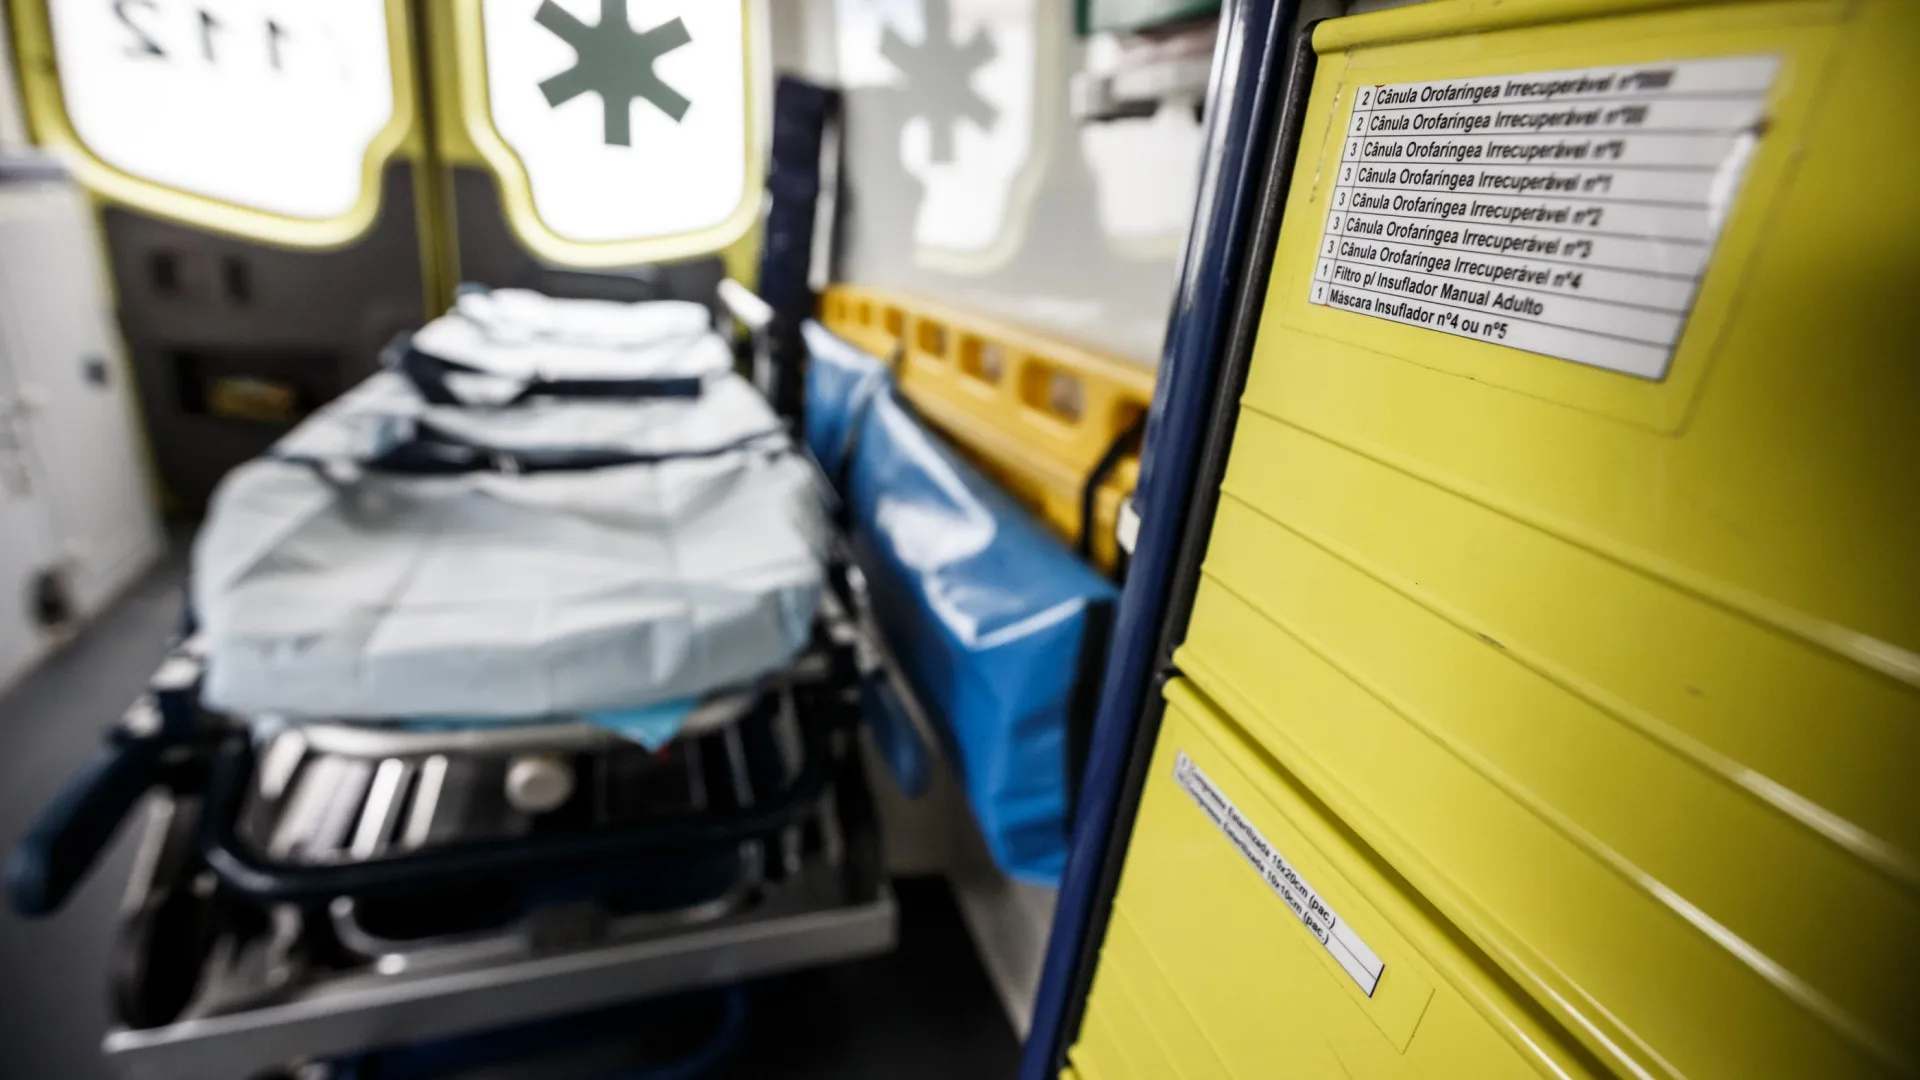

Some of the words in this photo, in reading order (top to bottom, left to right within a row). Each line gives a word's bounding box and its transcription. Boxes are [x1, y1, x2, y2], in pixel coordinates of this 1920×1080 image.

[1362, 91, 1370, 106] 2
[1377, 87, 1417, 105] Cânula
[1421, 83, 1500, 103] Orofaríngea
[1356, 117, 1364, 131] 2
[1370, 114, 1409, 131] Cânula
[1413, 112, 1491, 132] Orofaríngea
[1350, 142, 1357, 156] 3
[1364, 141, 1403, 157] Cânula
[1406, 140, 1481, 161] Orofaríngea
[1344, 167, 1351, 181] 3
[1358, 167, 1396, 184] Cânula
[1400, 165, 1474, 190] Orofaríngea
[1338, 192, 1345, 206] 3
[1352, 193, 1389, 210] Cânula
[1393, 195, 1466, 218] Orofaríngea
[1470, 201, 1570, 224] Irrecuperável
[1333, 216, 1340, 230] 3
[1346, 218, 1383, 235] Cânula
[1386, 221, 1458, 246] Orofaríngea
[1462, 229, 1560, 254] Irrecuperável
[1328, 240, 1334, 254] 3
[1340, 242, 1377, 260] Cânula
[1380, 246, 1450, 272] Orofaríngea
[1454, 257, 1551, 285] Irrecuperável
[1553, 271, 1584, 289] nº4
[1323, 264, 1328, 277] 1
[1334, 265, 1361, 283] Filtro
[1363, 272, 1375, 287] p/
[1377, 272, 1438, 297] Insuflador
[1440, 283, 1490, 306] Manual
[1492, 292, 1543, 316] Adulto
[1318, 287, 1322, 299] 1
[1330, 288, 1371, 310] Máscara
[1374, 297, 1435, 324] Insuflador
[1437, 312, 1460, 328] nº4
[1462, 319, 1479, 334] ou
[1483, 321, 1508, 339] nº5
[1273, 854, 1308, 898] 15x20cm
[1309, 894, 1335, 929] (pac.)
[1303, 911, 1329, 946] (pac.)
